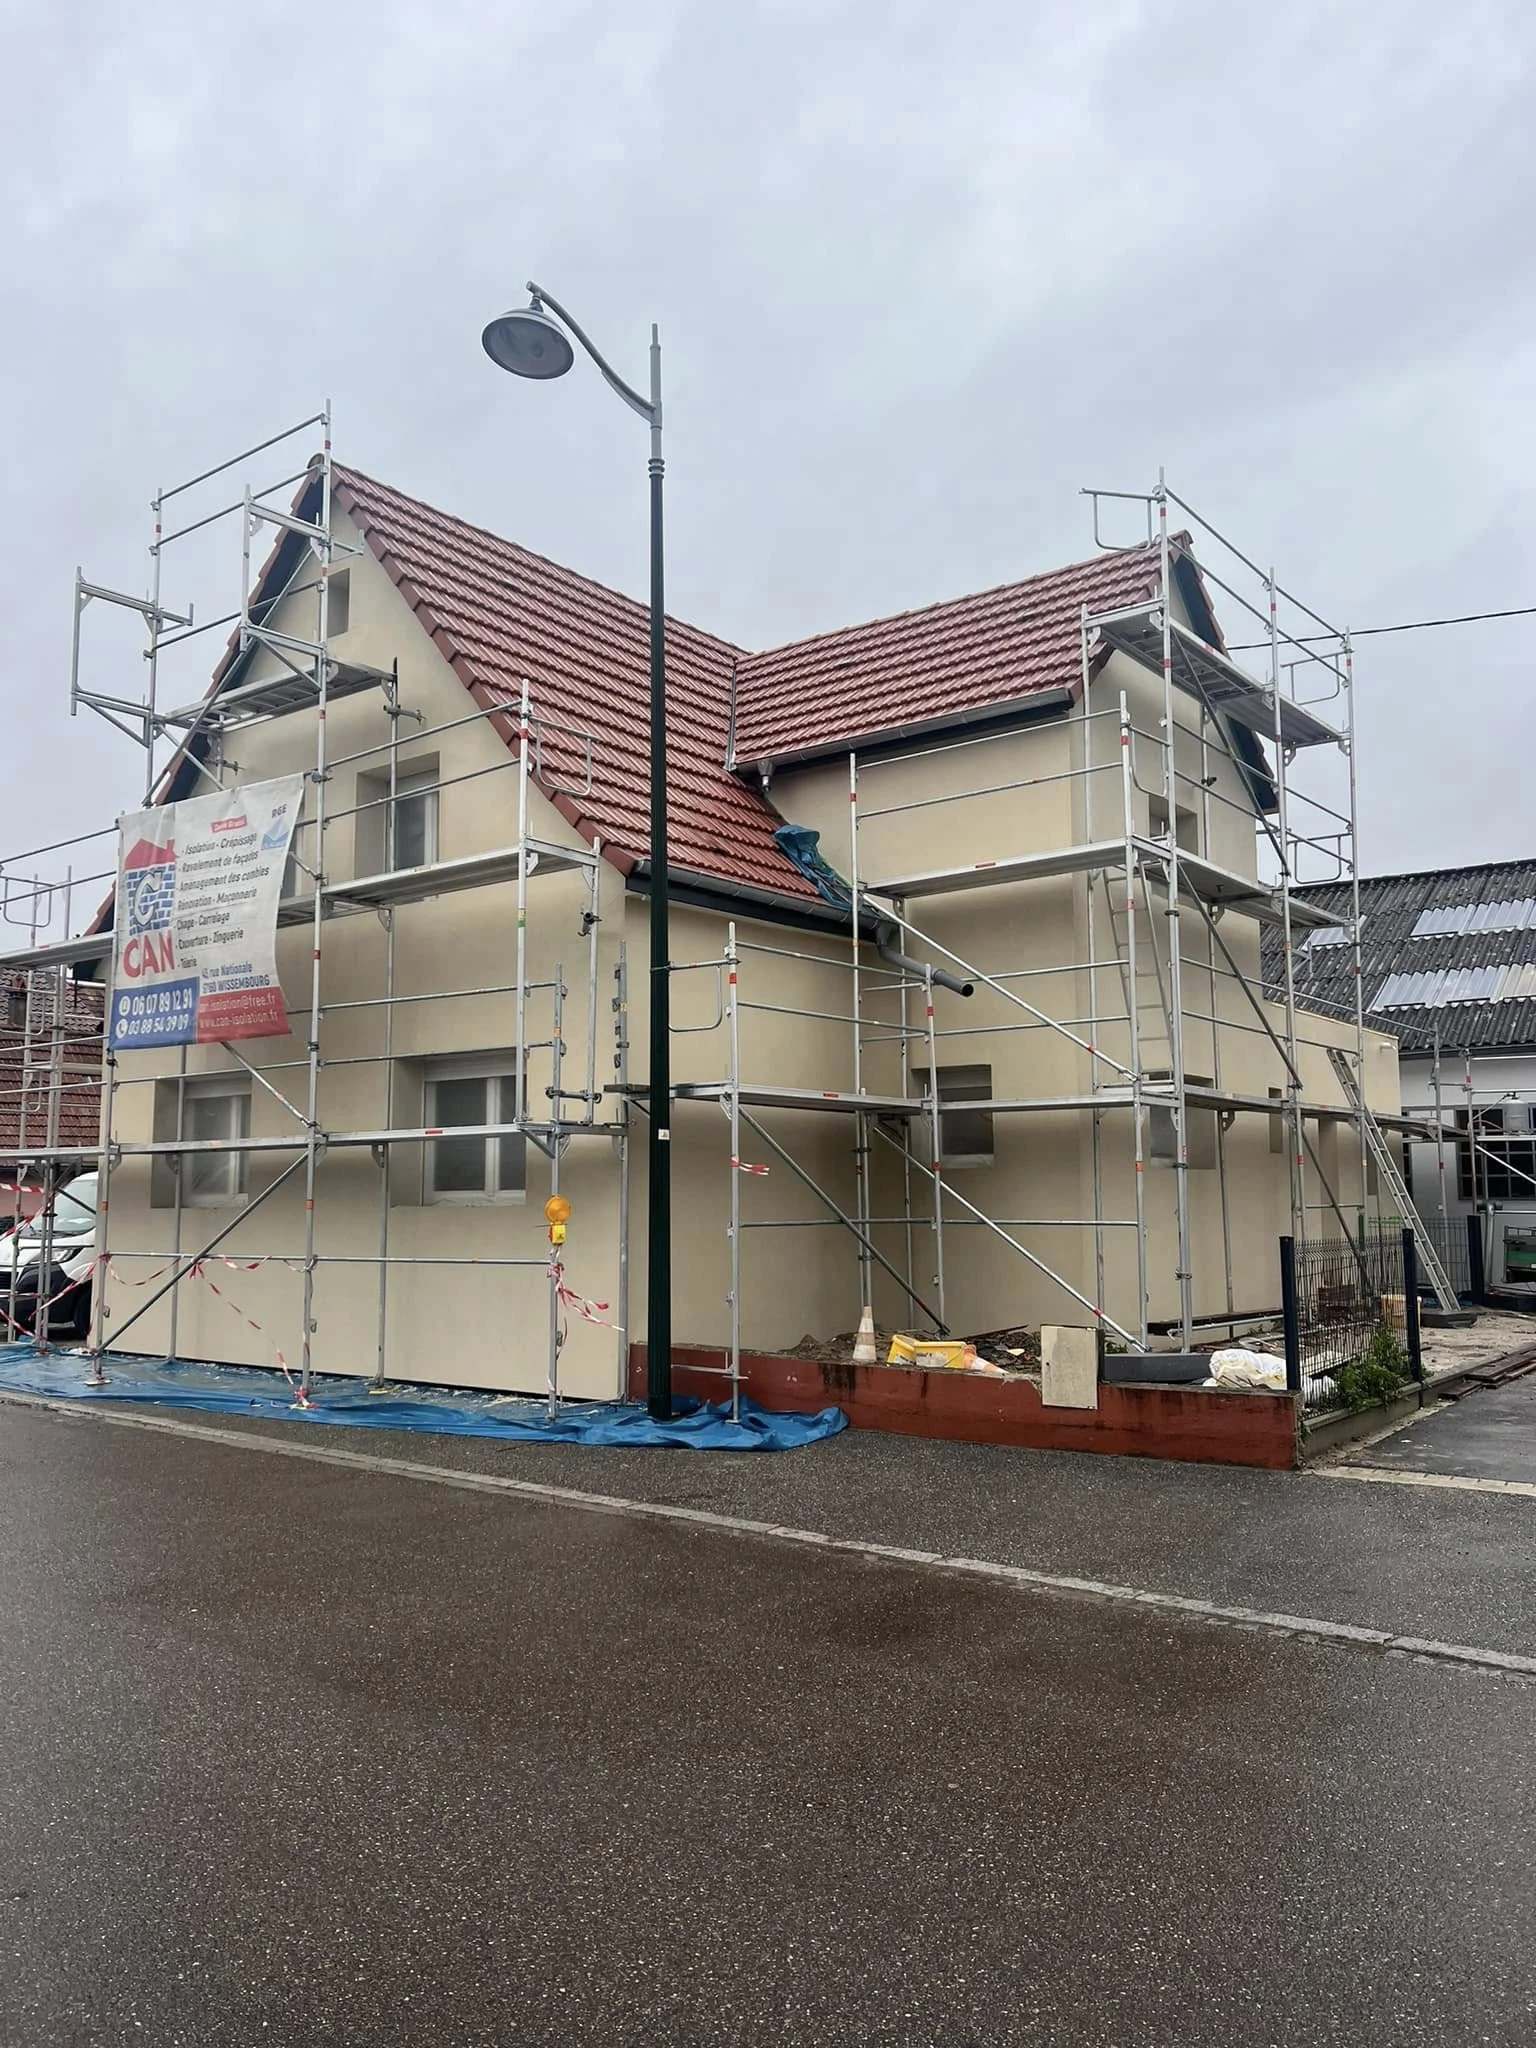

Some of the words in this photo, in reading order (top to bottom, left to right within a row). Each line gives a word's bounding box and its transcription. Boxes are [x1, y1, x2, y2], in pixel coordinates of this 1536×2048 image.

[272, 804, 287, 818] RGE
[185, 841, 215, 855] Isolation
[182, 857, 222, 873] Ravalement
[223, 855, 232, 866] de
[232, 851, 259, 866] façades
[228, 872, 241, 883] des
[241, 866, 270, 881] combles
[216, 888, 257, 904] Maçonnerie
[177, 919, 194, 930] Chape
[199, 912, 230, 925] Carrelage
[178, 936, 208, 949] Couverture
[213, 928, 244, 944] Zinguerie
[123, 930, 175, 978] CAN
[209, 968, 219, 977] rue
[220, 961, 253, 976] Nationale
[217, 974, 270, 992] WISSEMBOURG
[132, 995, 145, 1016] 06
[146, 993, 157, 1014] 07
[158, 992, 171, 1013] 89
[173, 990, 182, 1010] 12
[183, 988, 192, 1009] 91
[128, 1019, 141, 1035] 03
[141, 1018, 152, 1034] 88
[153, 1017, 164, 1033] 54
[166, 1015, 177, 1032] 39
[178, 1013, 189, 1030] 09
